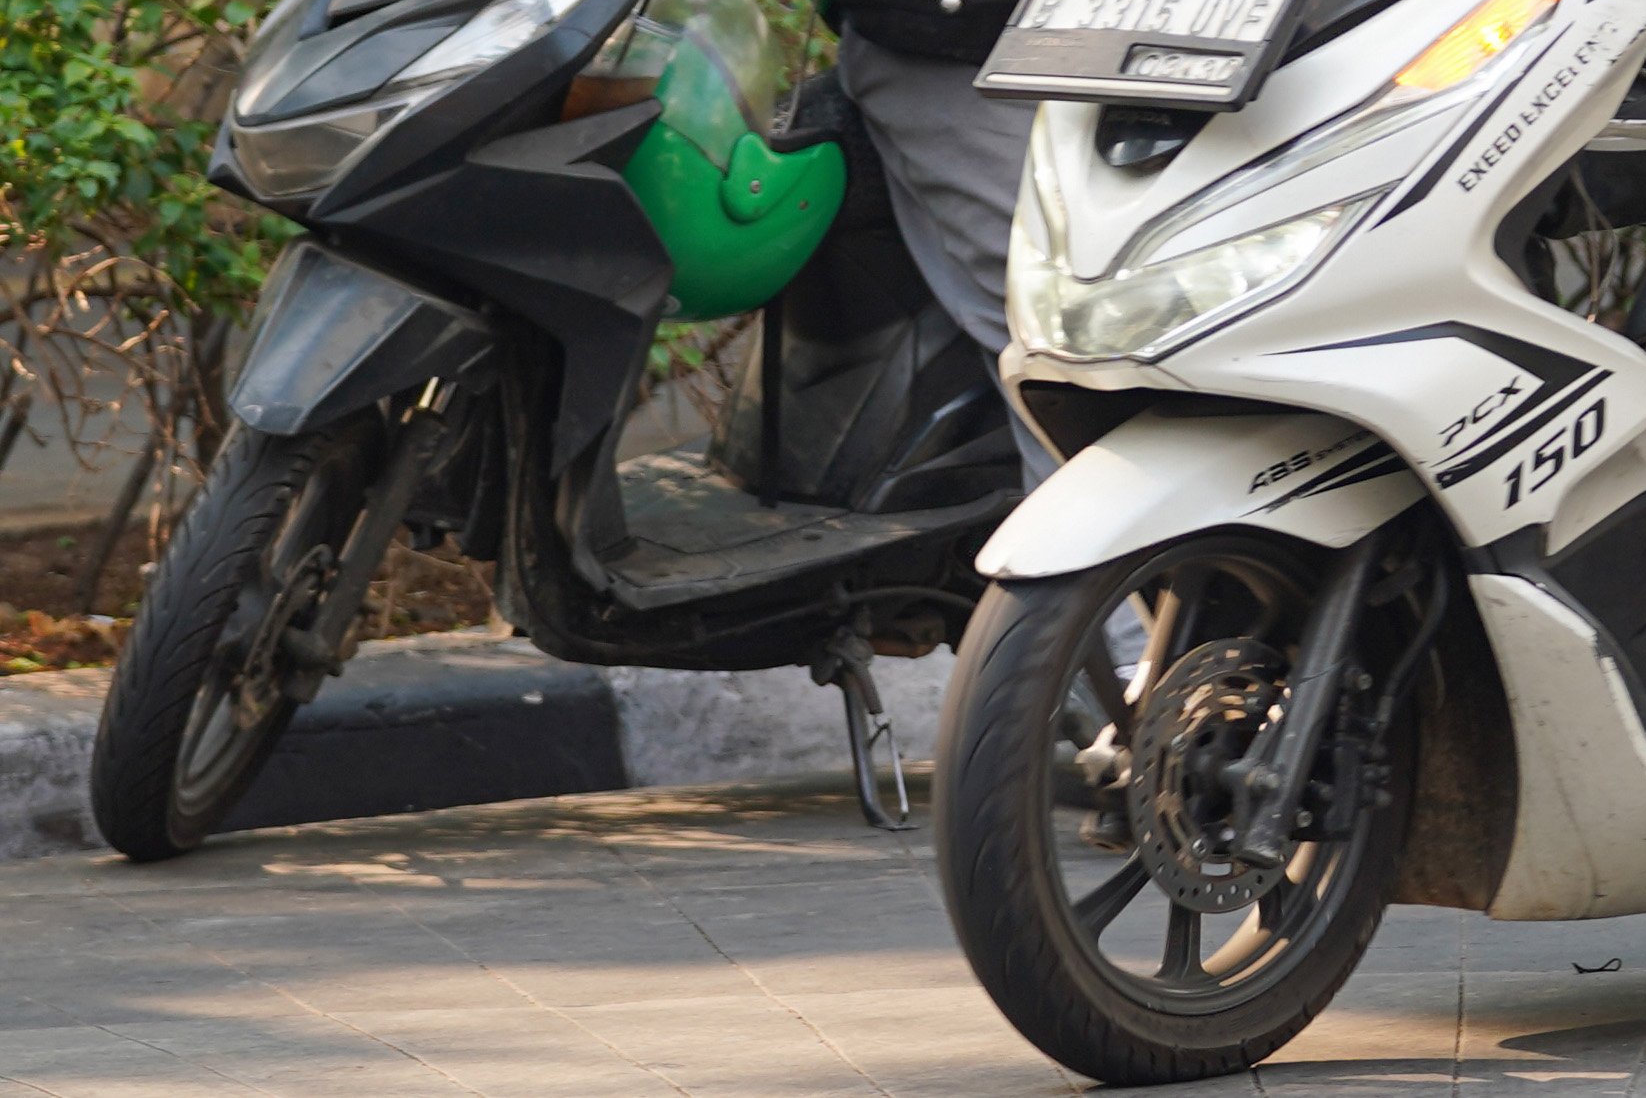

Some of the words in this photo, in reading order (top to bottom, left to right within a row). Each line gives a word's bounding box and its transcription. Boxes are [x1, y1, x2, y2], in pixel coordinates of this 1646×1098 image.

[1438, 375, 1522, 448] PCX
[1248, 449, 1312, 495] ABS
[1503, 397, 1607, 510] 150
